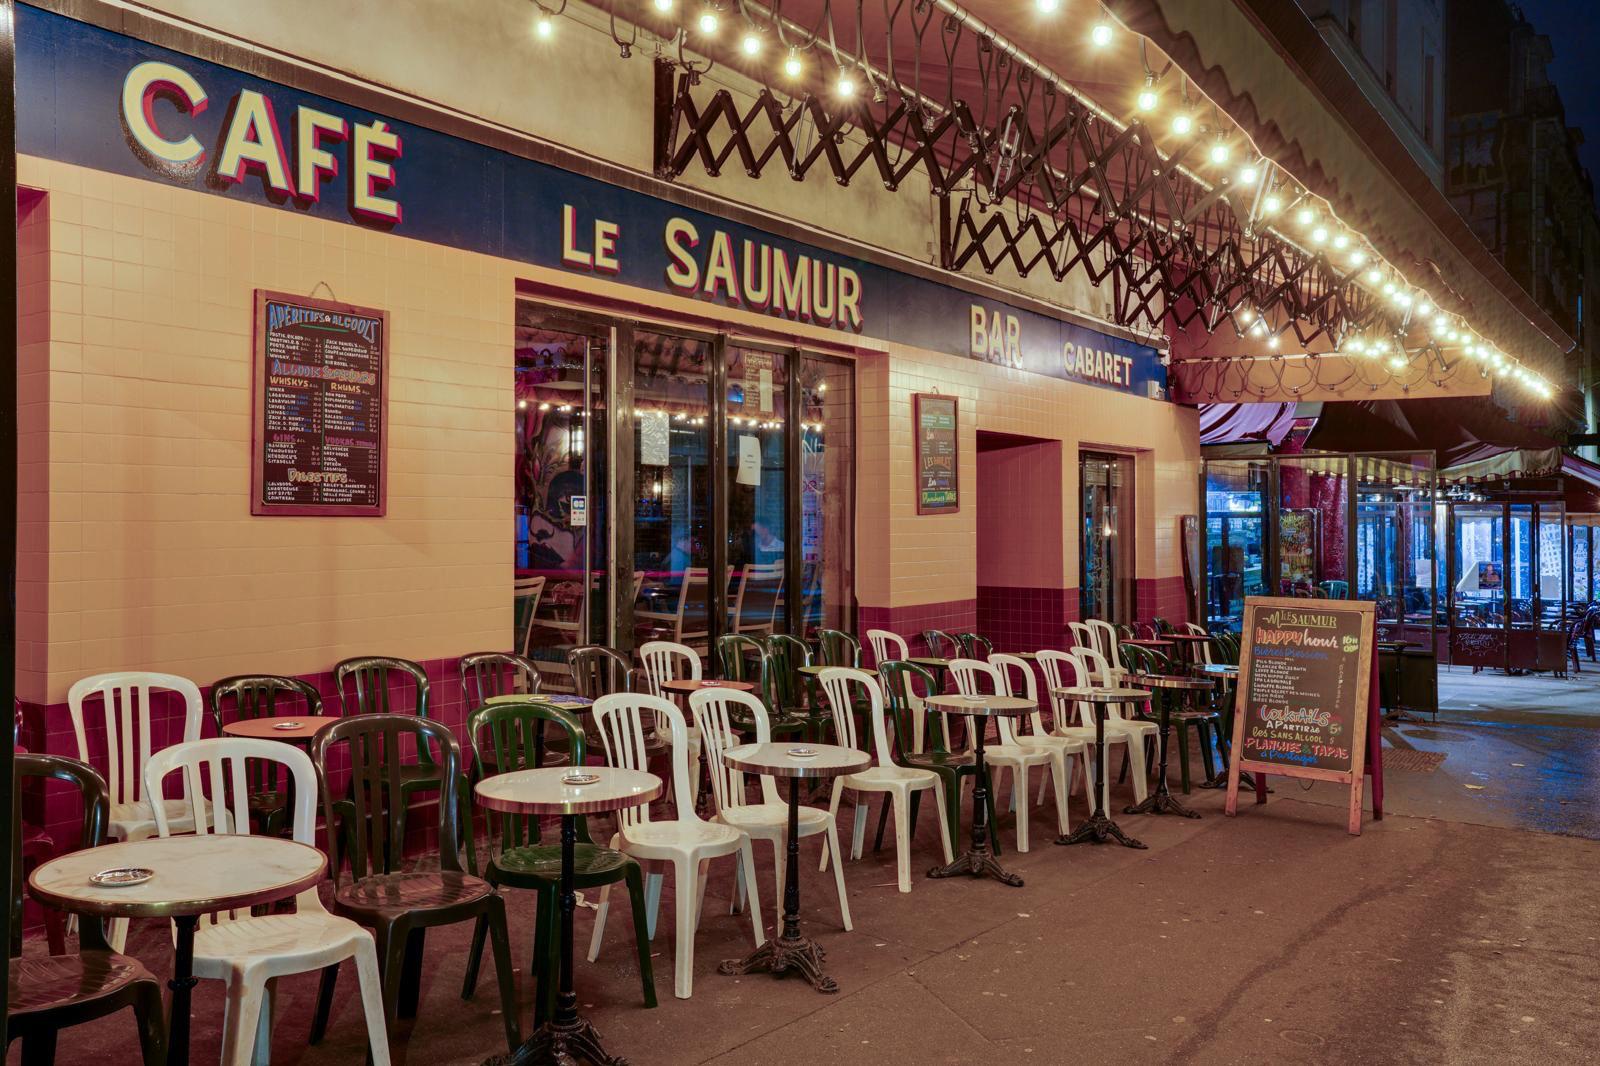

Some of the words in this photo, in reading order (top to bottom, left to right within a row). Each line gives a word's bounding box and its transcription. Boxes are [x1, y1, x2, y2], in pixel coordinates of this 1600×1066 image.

[122, 61, 402, 224] CAFÉ
[562, 204, 620, 271] LE
[664, 217, 863, 331] SAUMUR
[332, 315, 379, 343] ALCOOLS
[970, 304, 1023, 369] BAR
[1062, 342, 1132, 387] CABARET
[270, 376, 308, 387] WHISKYS
[331, 383, 360, 393] RHUMS
[1291, 612, 1336, 626] SAUMUR
[1256, 627, 1303, 646] HAPPY
[1303, 628, 1338, 648] hour
[1275, 721, 1310, 732] PARTIR
[1270, 730, 1293, 740] SANS
[1295, 733, 1323, 743] ALCOOL
[1312, 744, 1349, 759] TAPAS
